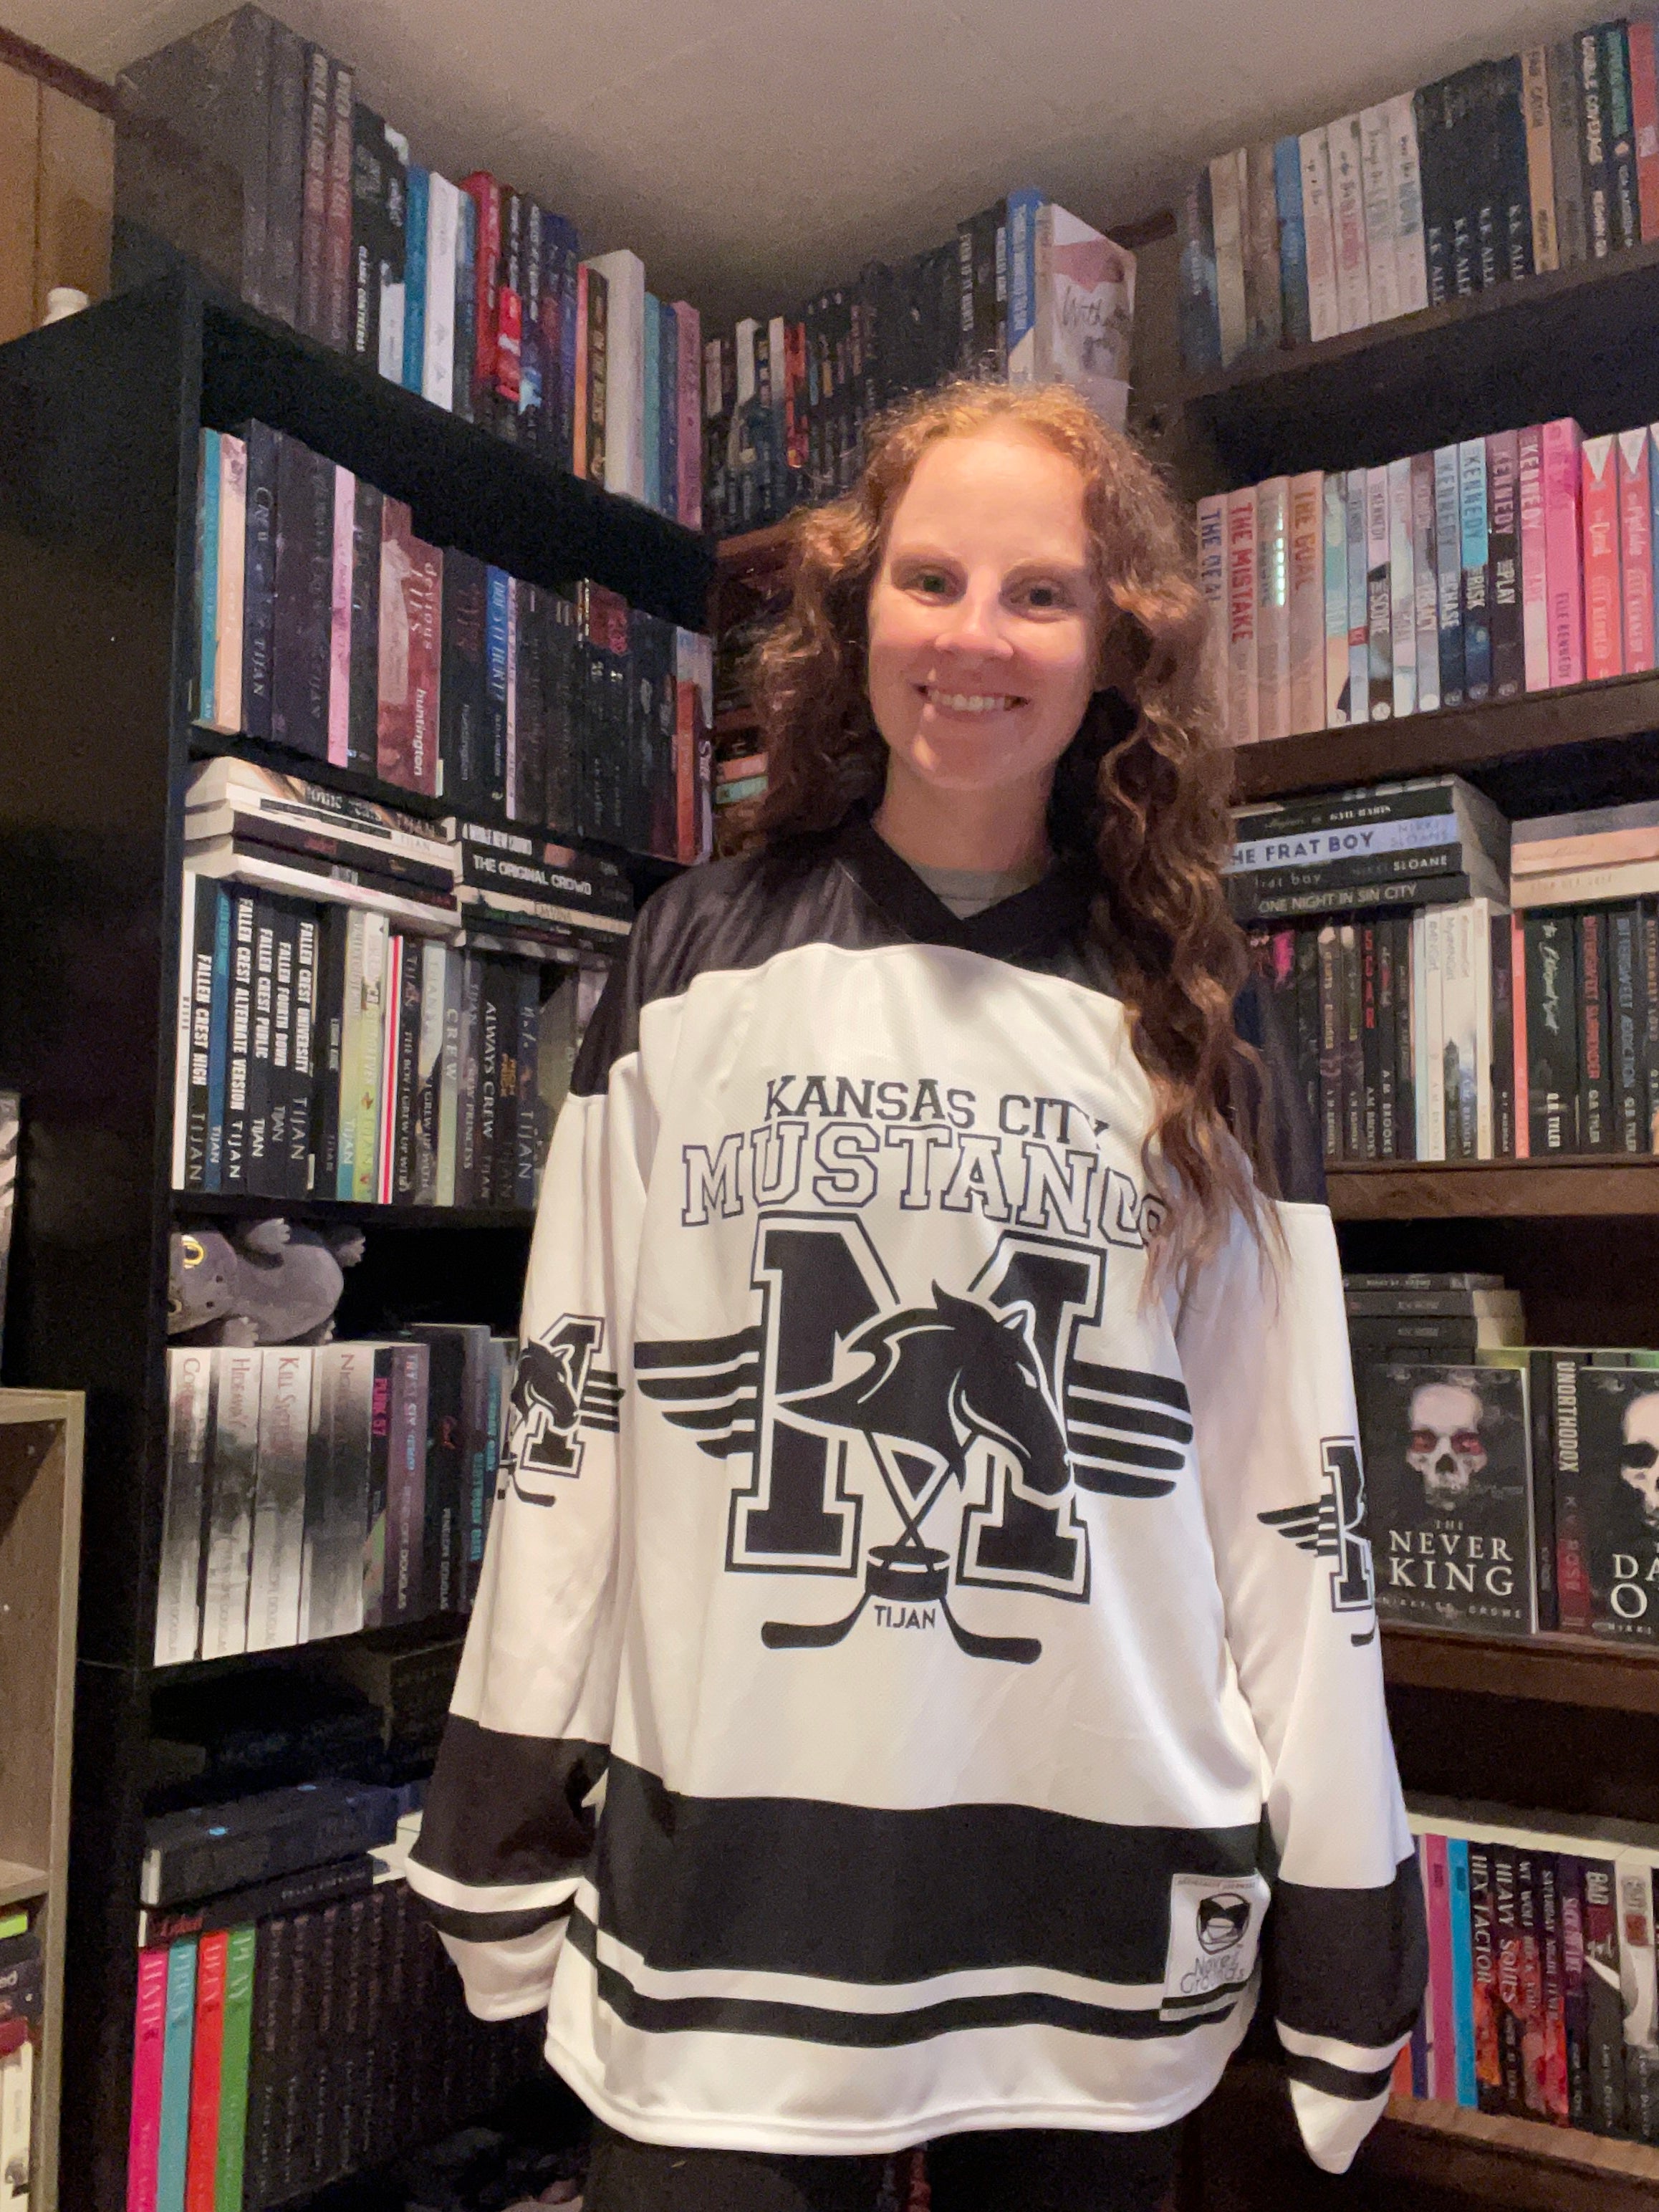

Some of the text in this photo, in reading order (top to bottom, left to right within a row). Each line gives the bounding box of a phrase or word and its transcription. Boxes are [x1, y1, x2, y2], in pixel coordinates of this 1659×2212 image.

[1437, 462, 1457, 548] KENNEDY
[1463, 454, 1484, 540] KENNEDY
[1493, 449, 1514, 534] KENNEDY
[1520, 443, 1542, 529] KENNEDY
[1201, 509, 1222, 548] THE
[1294, 487, 1317, 592] THE GOAL
[1371, 492, 1385, 542] KENNEDY
[1231, 502, 1254, 644] THE MISTAKE
[1467, 576, 1485, 610] RISK
[1496, 570, 1515, 605] PLAY
[1372, 593, 1389, 634] SCORE
[1441, 583, 1459, 630] CHASE
[1556, 592, 1570, 678] ELLE KENNEDY
[1628, 601, 1645, 653] KENNEDY
[413, 688, 426, 776] huntington
[473, 854, 592, 896] THE ORIGINAL CROWD
[1231, 830, 1375, 866] HE FRAT BOY
[1393, 855, 1447, 872] SLOANE
[1258, 882, 1418, 913] ONE NIGHT IN SIN CITY
[1617, 918, 1633, 1009] BITTERSWEET
[188, 954, 212, 1181] FALLEN CREST HIGH TIJAN
[227, 898, 254, 1179] FALLEN CREST ALTERNATE VERSION TIJAN
[251, 928, 273, 1158] FALLEN CREST PUBLIC TIJAN
[271, 941, 292, 1143] FALLEN FOURTH DOWN TIJAN
[289, 921, 314, 1160] FALLEN CREST UNIVERSITY TIJAN
[446, 1008, 458, 1080] CREW
[483, 1001, 497, 1074] ALWAYS
[1620, 1014, 1635, 1088] ADDICTION
[423, 1090, 432, 1129] GREW
[481, 1081, 496, 1140] CREW
[764, 1073, 978, 1130] KANSAS
[210, 1124, 222, 1164] TIJAN
[342, 1117, 356, 1164] TIJAN
[464, 1103, 474, 1169] PRINCESS
[517, 1110, 534, 1179] TIJAN
[229, 1358, 251, 1428] HIDEAWAY
[276, 1357, 299, 1388] KILL
[372, 1377, 388, 1437] PUNK 57
[1556, 1362, 1579, 1473] UNORTHODOX
[1388, 1529, 1514, 1562] NEVER
[1436, 1519, 1464, 1531] THE
[398, 1549, 409, 1610] DOUGLAS
[440, 1561, 450, 1610] DOUGLAS
[1388, 1556, 1514, 1597] KING
[1612, 1552, 1659, 1584] DA
[875, 1605, 936, 1630] TIJAN
[1471, 1855, 1492, 1984] HEX FACTOR
[1541, 1870, 1556, 1933] SATURDAY
[1495, 1862, 1520, 2004] HEAVY SOULS
